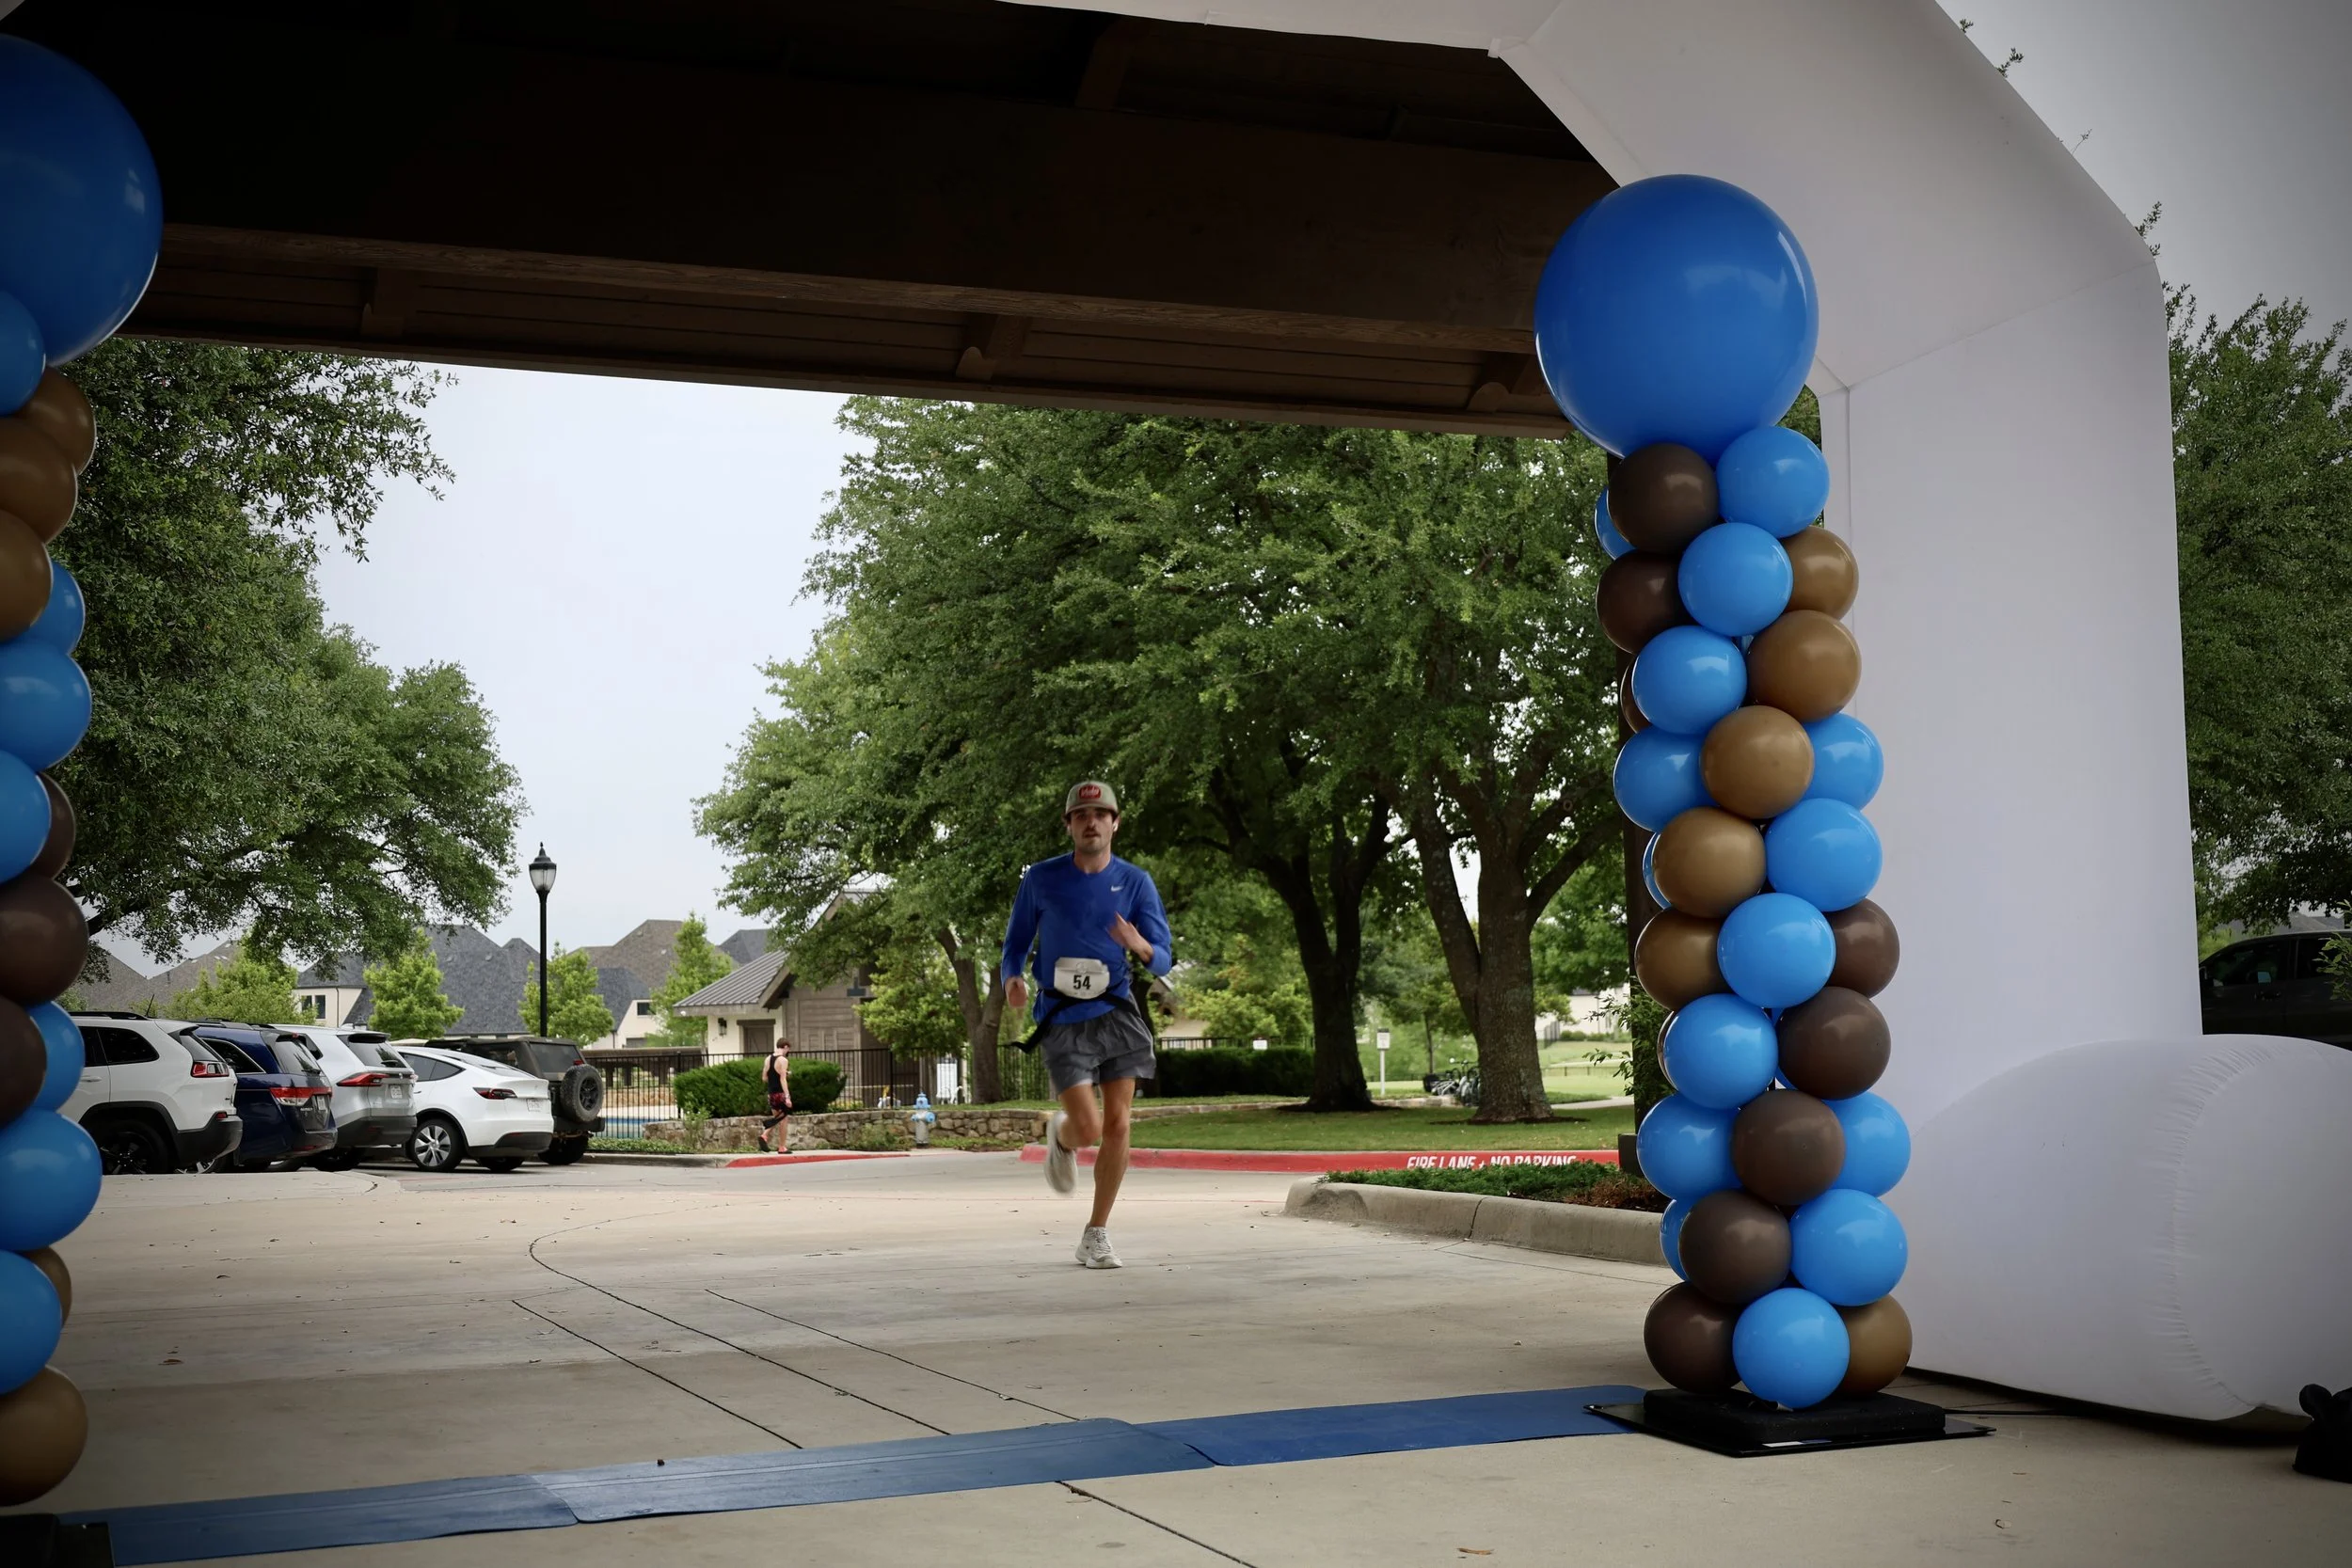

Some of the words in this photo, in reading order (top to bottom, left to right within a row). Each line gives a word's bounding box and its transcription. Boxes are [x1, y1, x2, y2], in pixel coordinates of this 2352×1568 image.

[1073, 974, 1091, 990] 54
[1406, 1156, 1438, 1169] FIRE
[1438, 1156, 1476, 1169] LANE
[1490, 1156, 1510, 1166] NO
